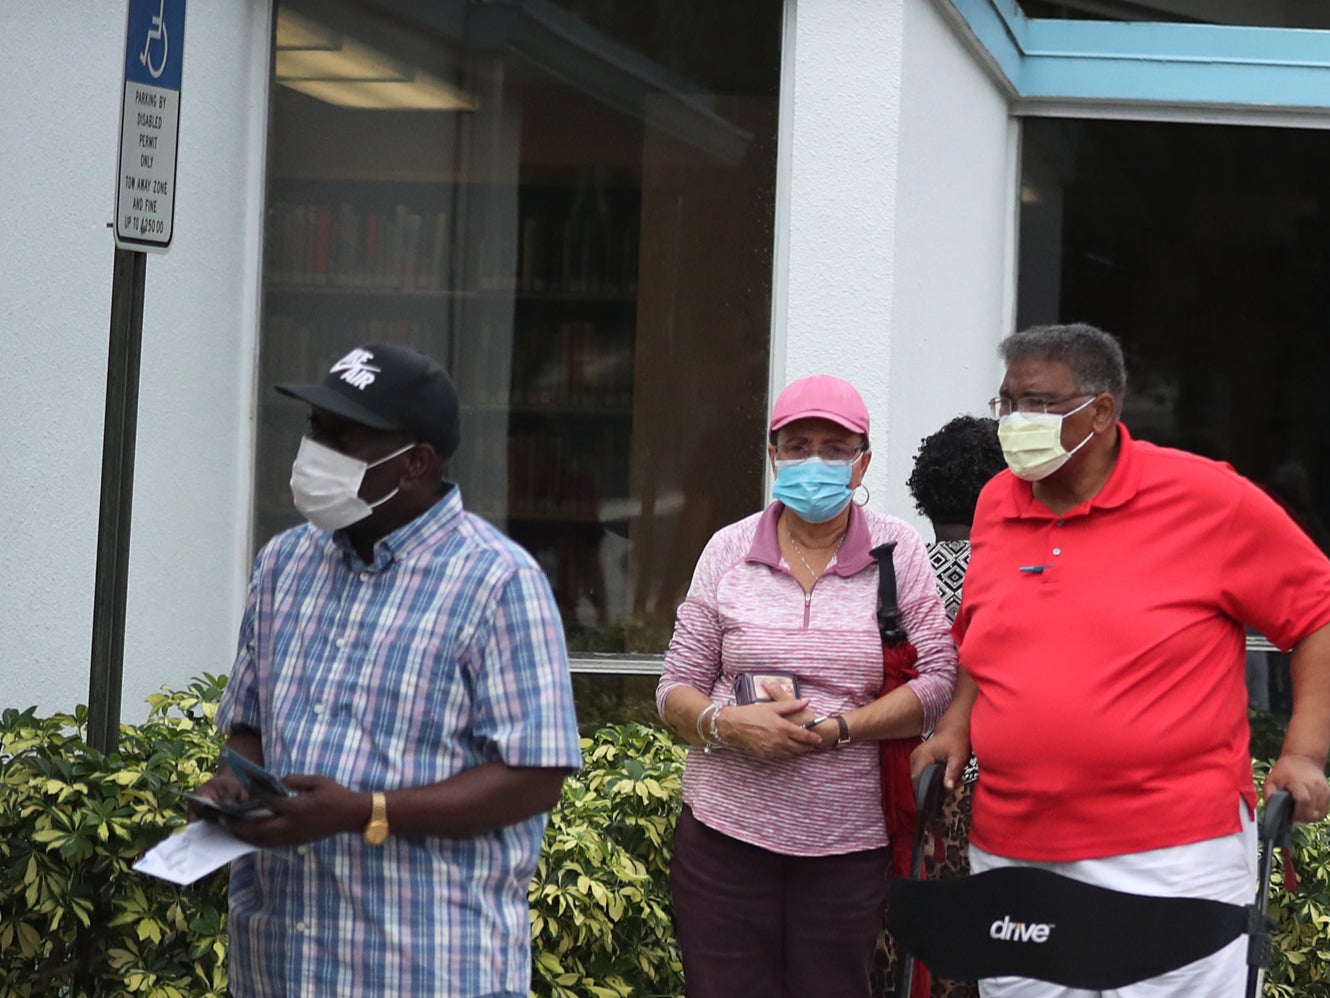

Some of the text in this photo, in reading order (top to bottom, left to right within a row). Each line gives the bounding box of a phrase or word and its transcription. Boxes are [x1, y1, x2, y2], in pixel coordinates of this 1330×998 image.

[136, 90, 167, 109] PARKING BY
[137, 112, 162, 129] DISABLED
[139, 133, 158, 149] PERMIT
[140, 154, 154, 168] ONLY
[126, 175, 167, 195] TOW AWAY ZONE
[132, 197, 157, 213] AND FINE
[125, 216, 131, 229] UP
[133, 217, 140, 231] TO
[339, 370, 375, 391] AIR
[989, 915, 1051, 943] drive
